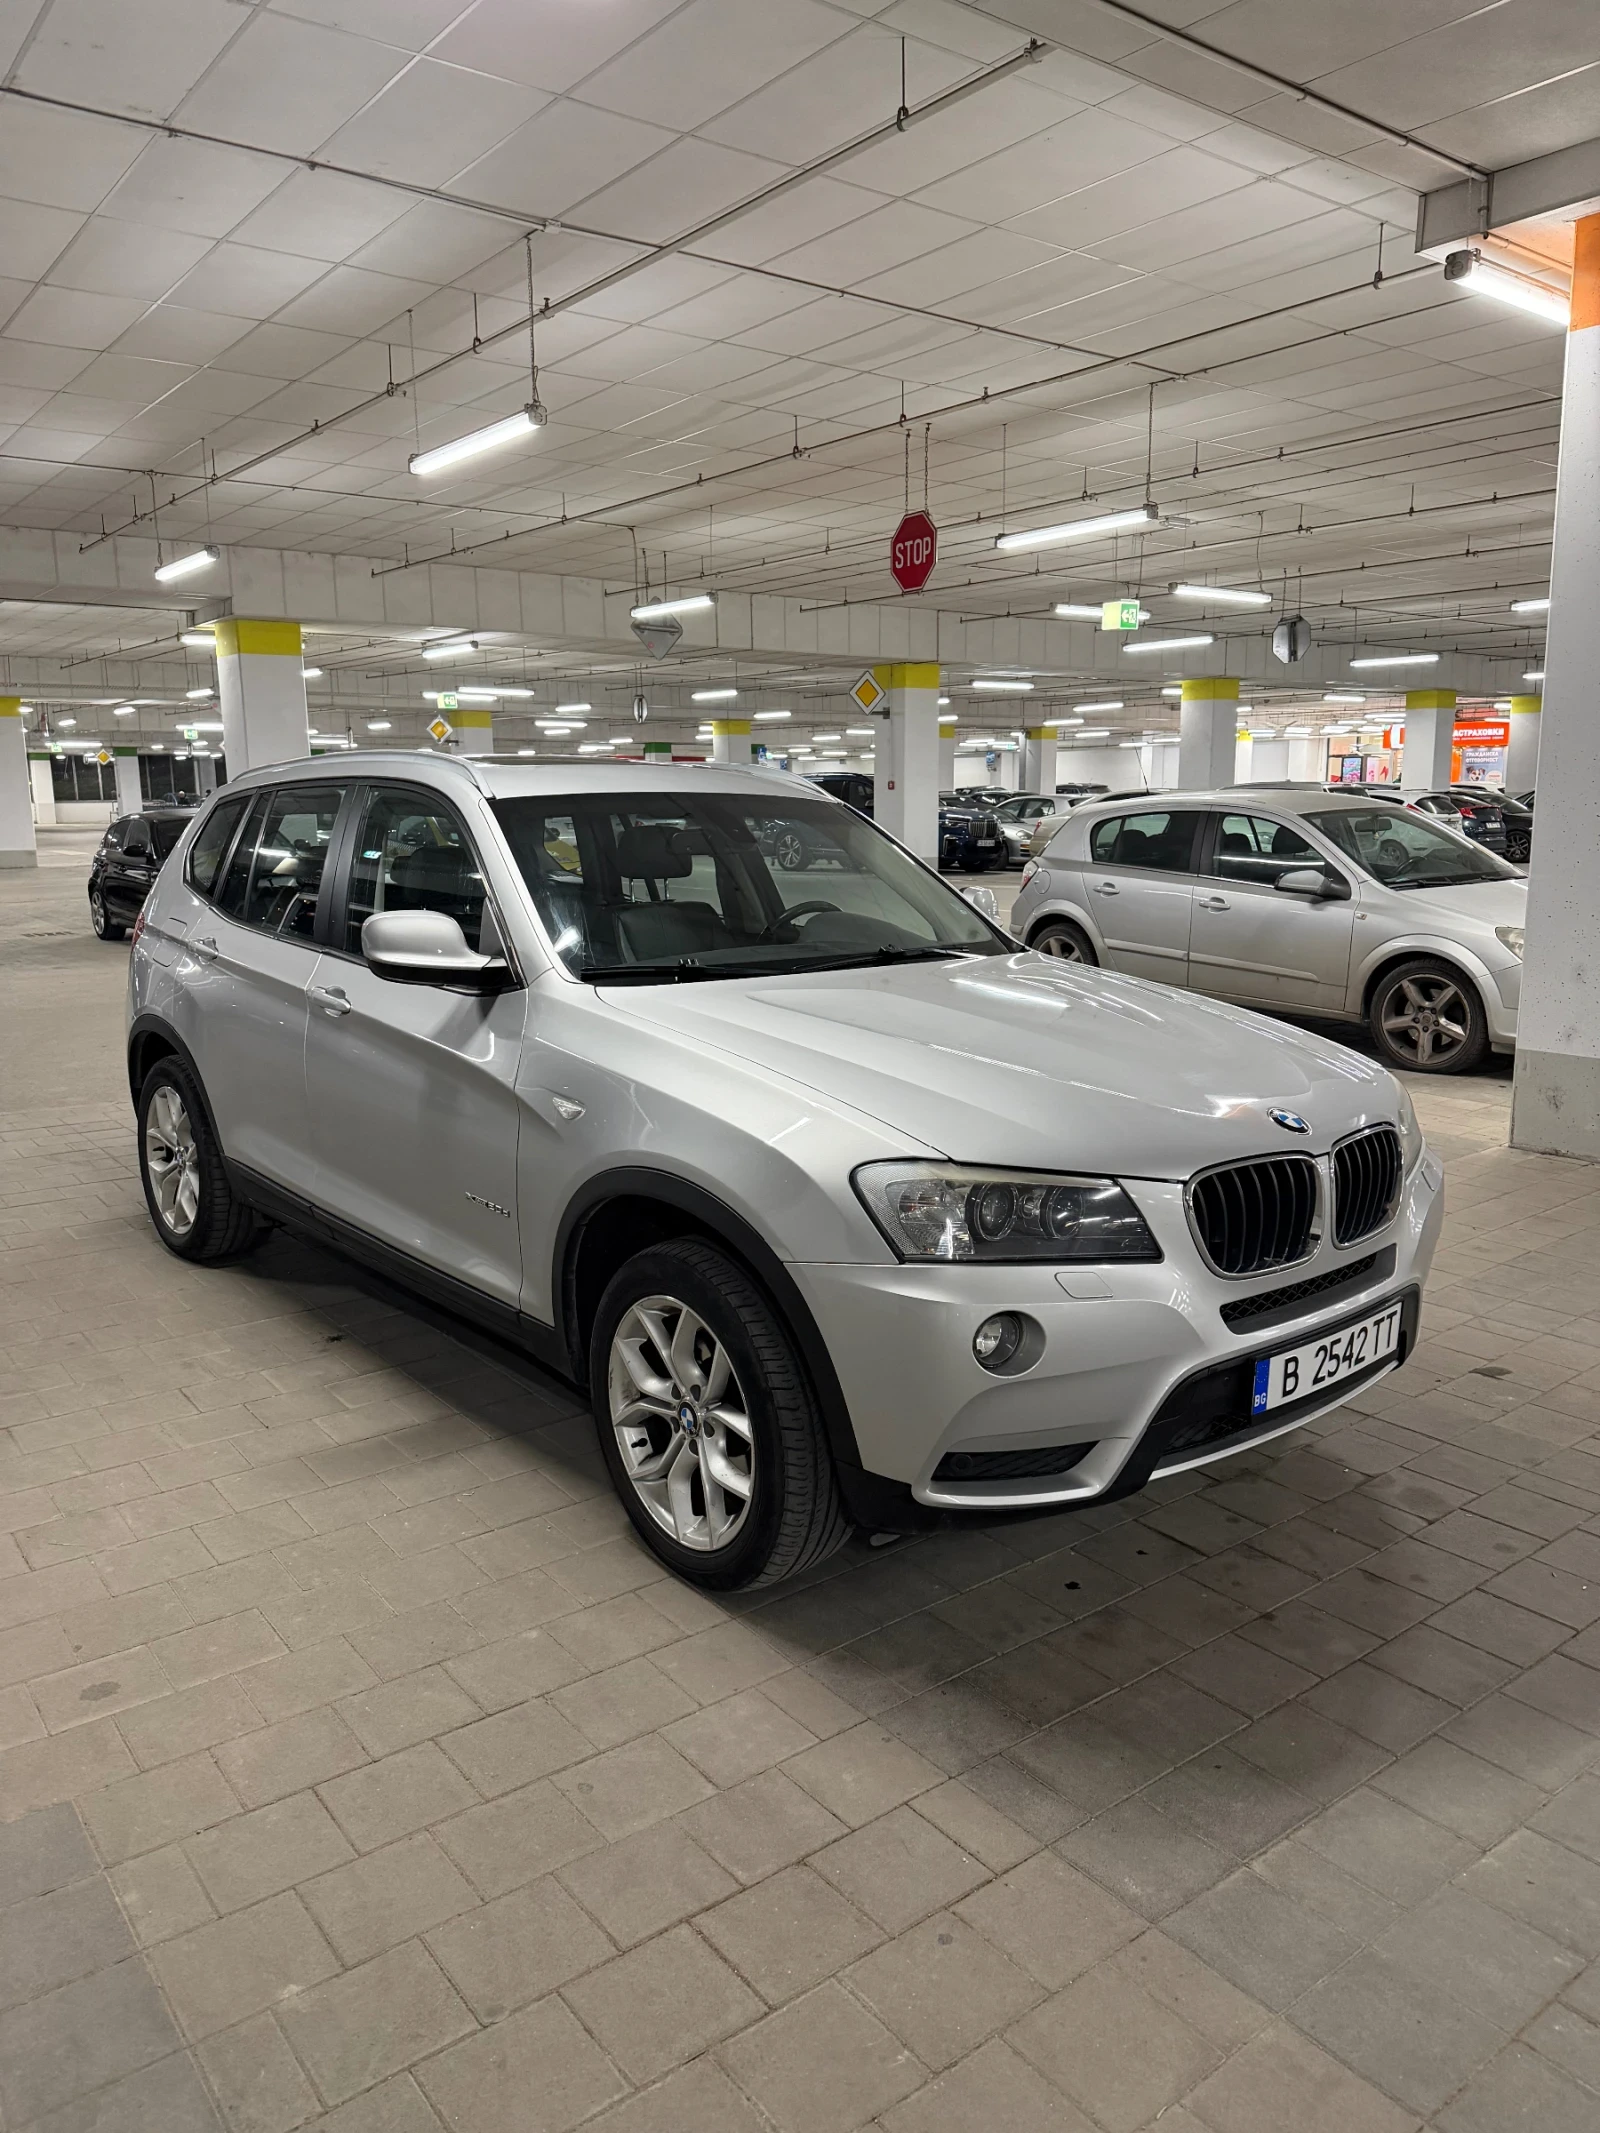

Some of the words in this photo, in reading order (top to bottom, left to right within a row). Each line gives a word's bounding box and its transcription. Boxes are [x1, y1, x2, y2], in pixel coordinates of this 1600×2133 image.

[895, 536, 932, 569] STOP
[1452, 728, 1505, 737] АСТРАХОВКИ
[1282, 1355, 1299, 1398] B
[1312, 1325, 1369, 1386] 2542
[1373, 1310, 1398, 1356] TT
[1253, 1392, 1267, 1407] BG
